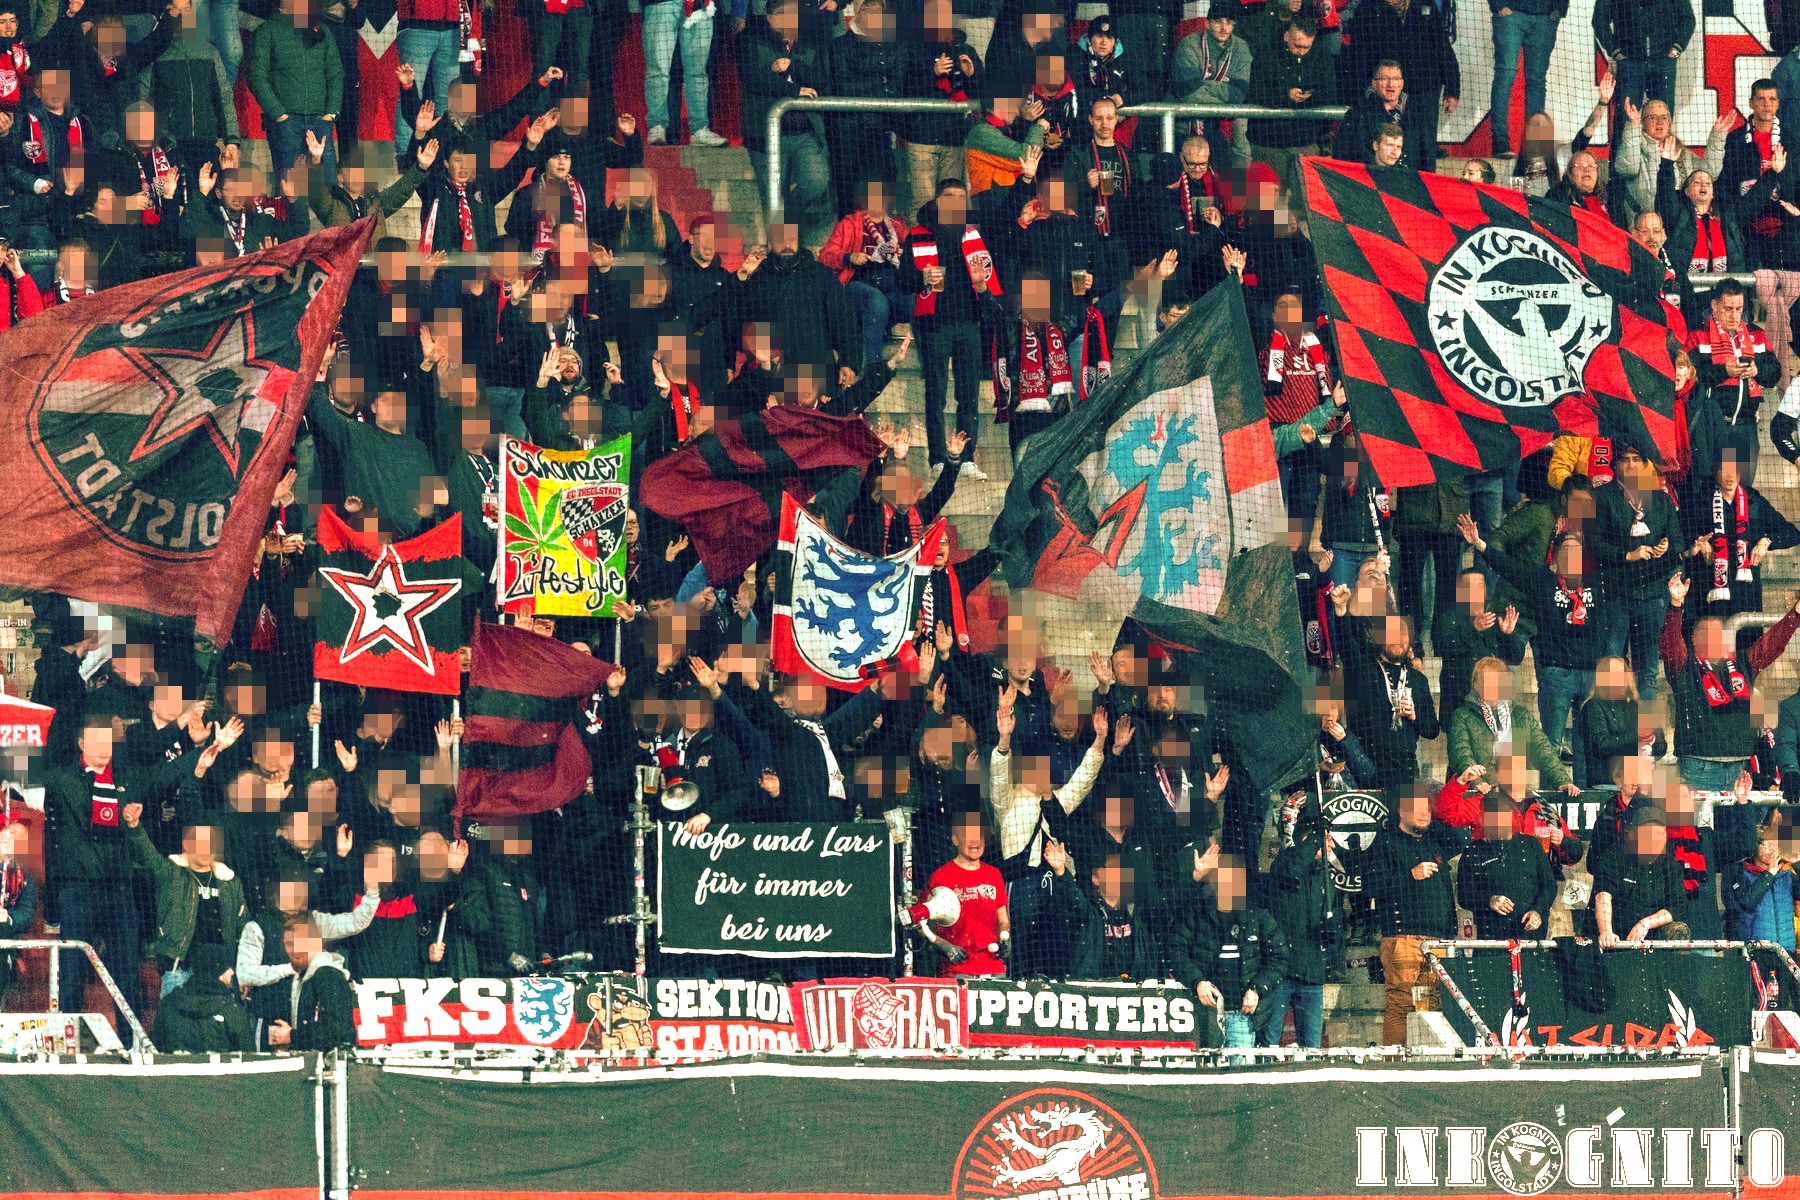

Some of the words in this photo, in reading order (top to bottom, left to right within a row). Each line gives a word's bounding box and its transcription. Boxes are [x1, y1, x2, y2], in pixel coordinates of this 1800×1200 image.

[1437, 260, 1474, 296] IN
[506, 439, 623, 480] Schanzer
[1594, 445, 1610, 466] 04
[577, 487, 623, 498] INGOLSTADT
[569, 499, 626, 539] SCHANZER
[583, 538, 593, 547] 04
[505, 553, 625, 610] Lifestyle
[753, 827, 815, 852] und
[820, 825, 883, 857] Lars
[695, 867, 747, 905] für
[754, 872, 853, 897] immer
[720, 914, 769, 941] bei
[775, 922, 833, 942] uns
[355, 977, 507, 1040] FKS
[1497, 1132, 1510, 1146] IN
[1511, 1125, 1560, 1155] KOGNITO
[1490, 1160, 1555, 1193] INGOLSTADT
